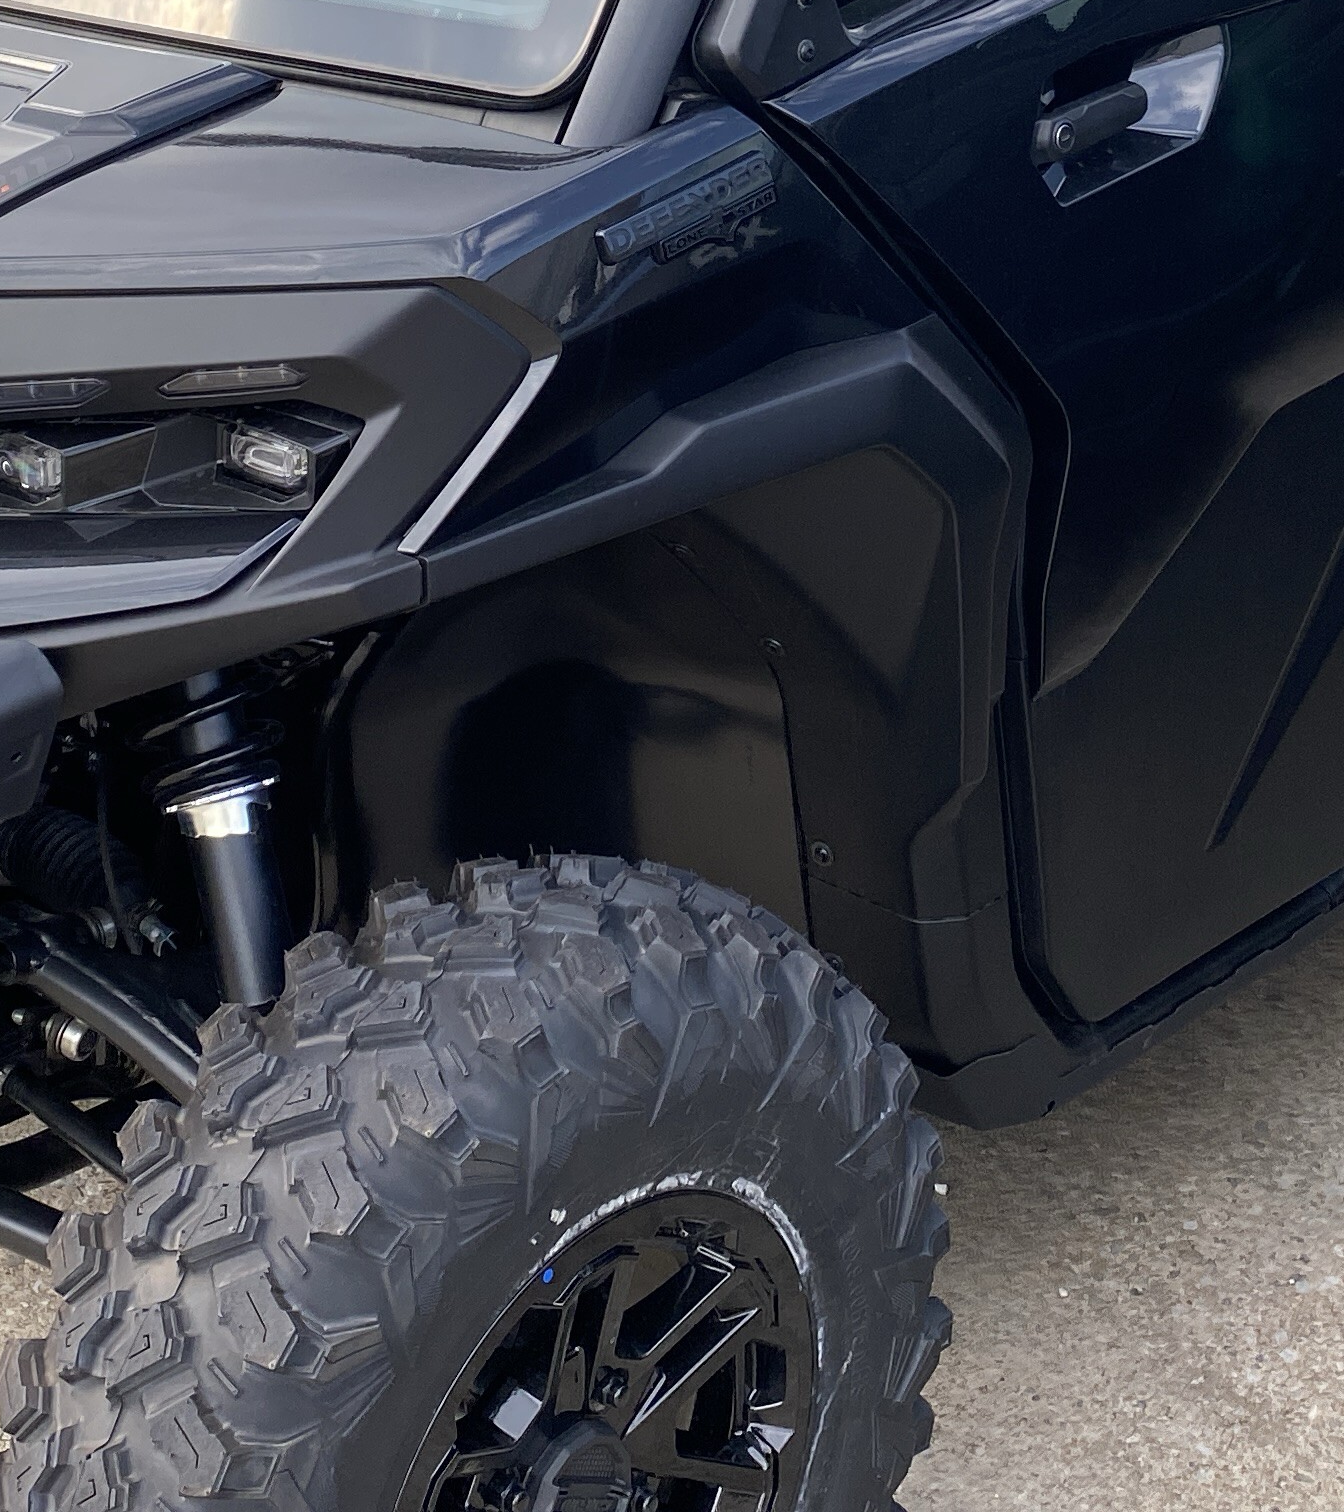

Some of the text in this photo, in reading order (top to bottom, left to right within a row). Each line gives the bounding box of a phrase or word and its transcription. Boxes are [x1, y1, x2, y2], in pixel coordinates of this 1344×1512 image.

[604, 157, 770, 256] DEFENDER
[666, 191, 774, 255] LONE STAR
